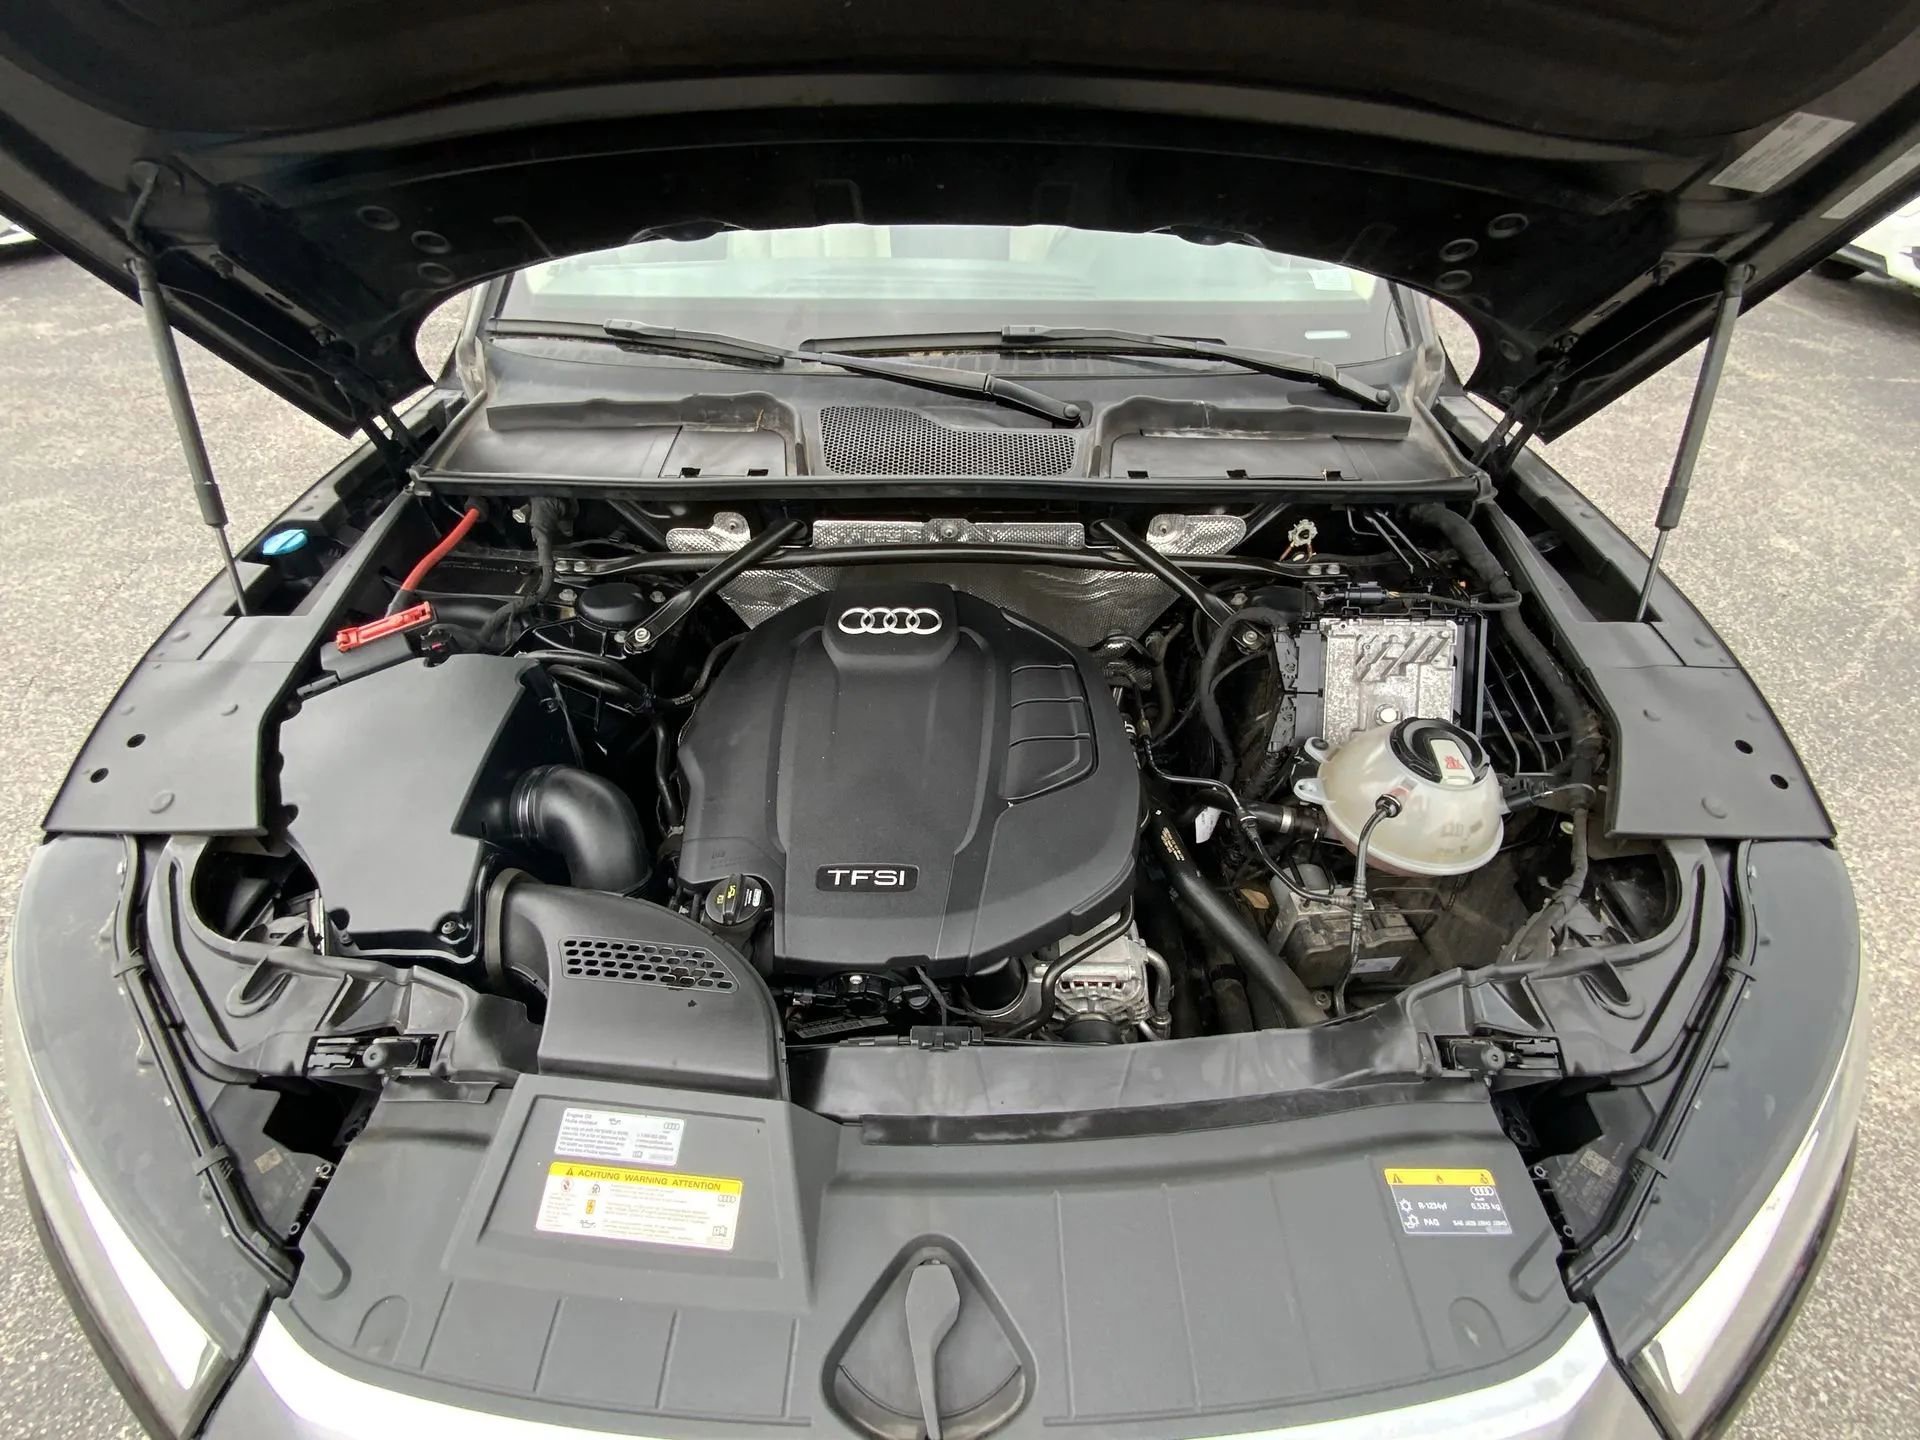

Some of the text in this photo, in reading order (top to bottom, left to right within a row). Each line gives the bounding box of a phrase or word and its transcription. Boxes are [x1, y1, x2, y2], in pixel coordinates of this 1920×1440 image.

[827, 869, 905, 886] TFSI
[577, 1169, 721, 1190] ACHTUNG WARNING ATTENTION
[1423, 1218, 1440, 1226] PAG
